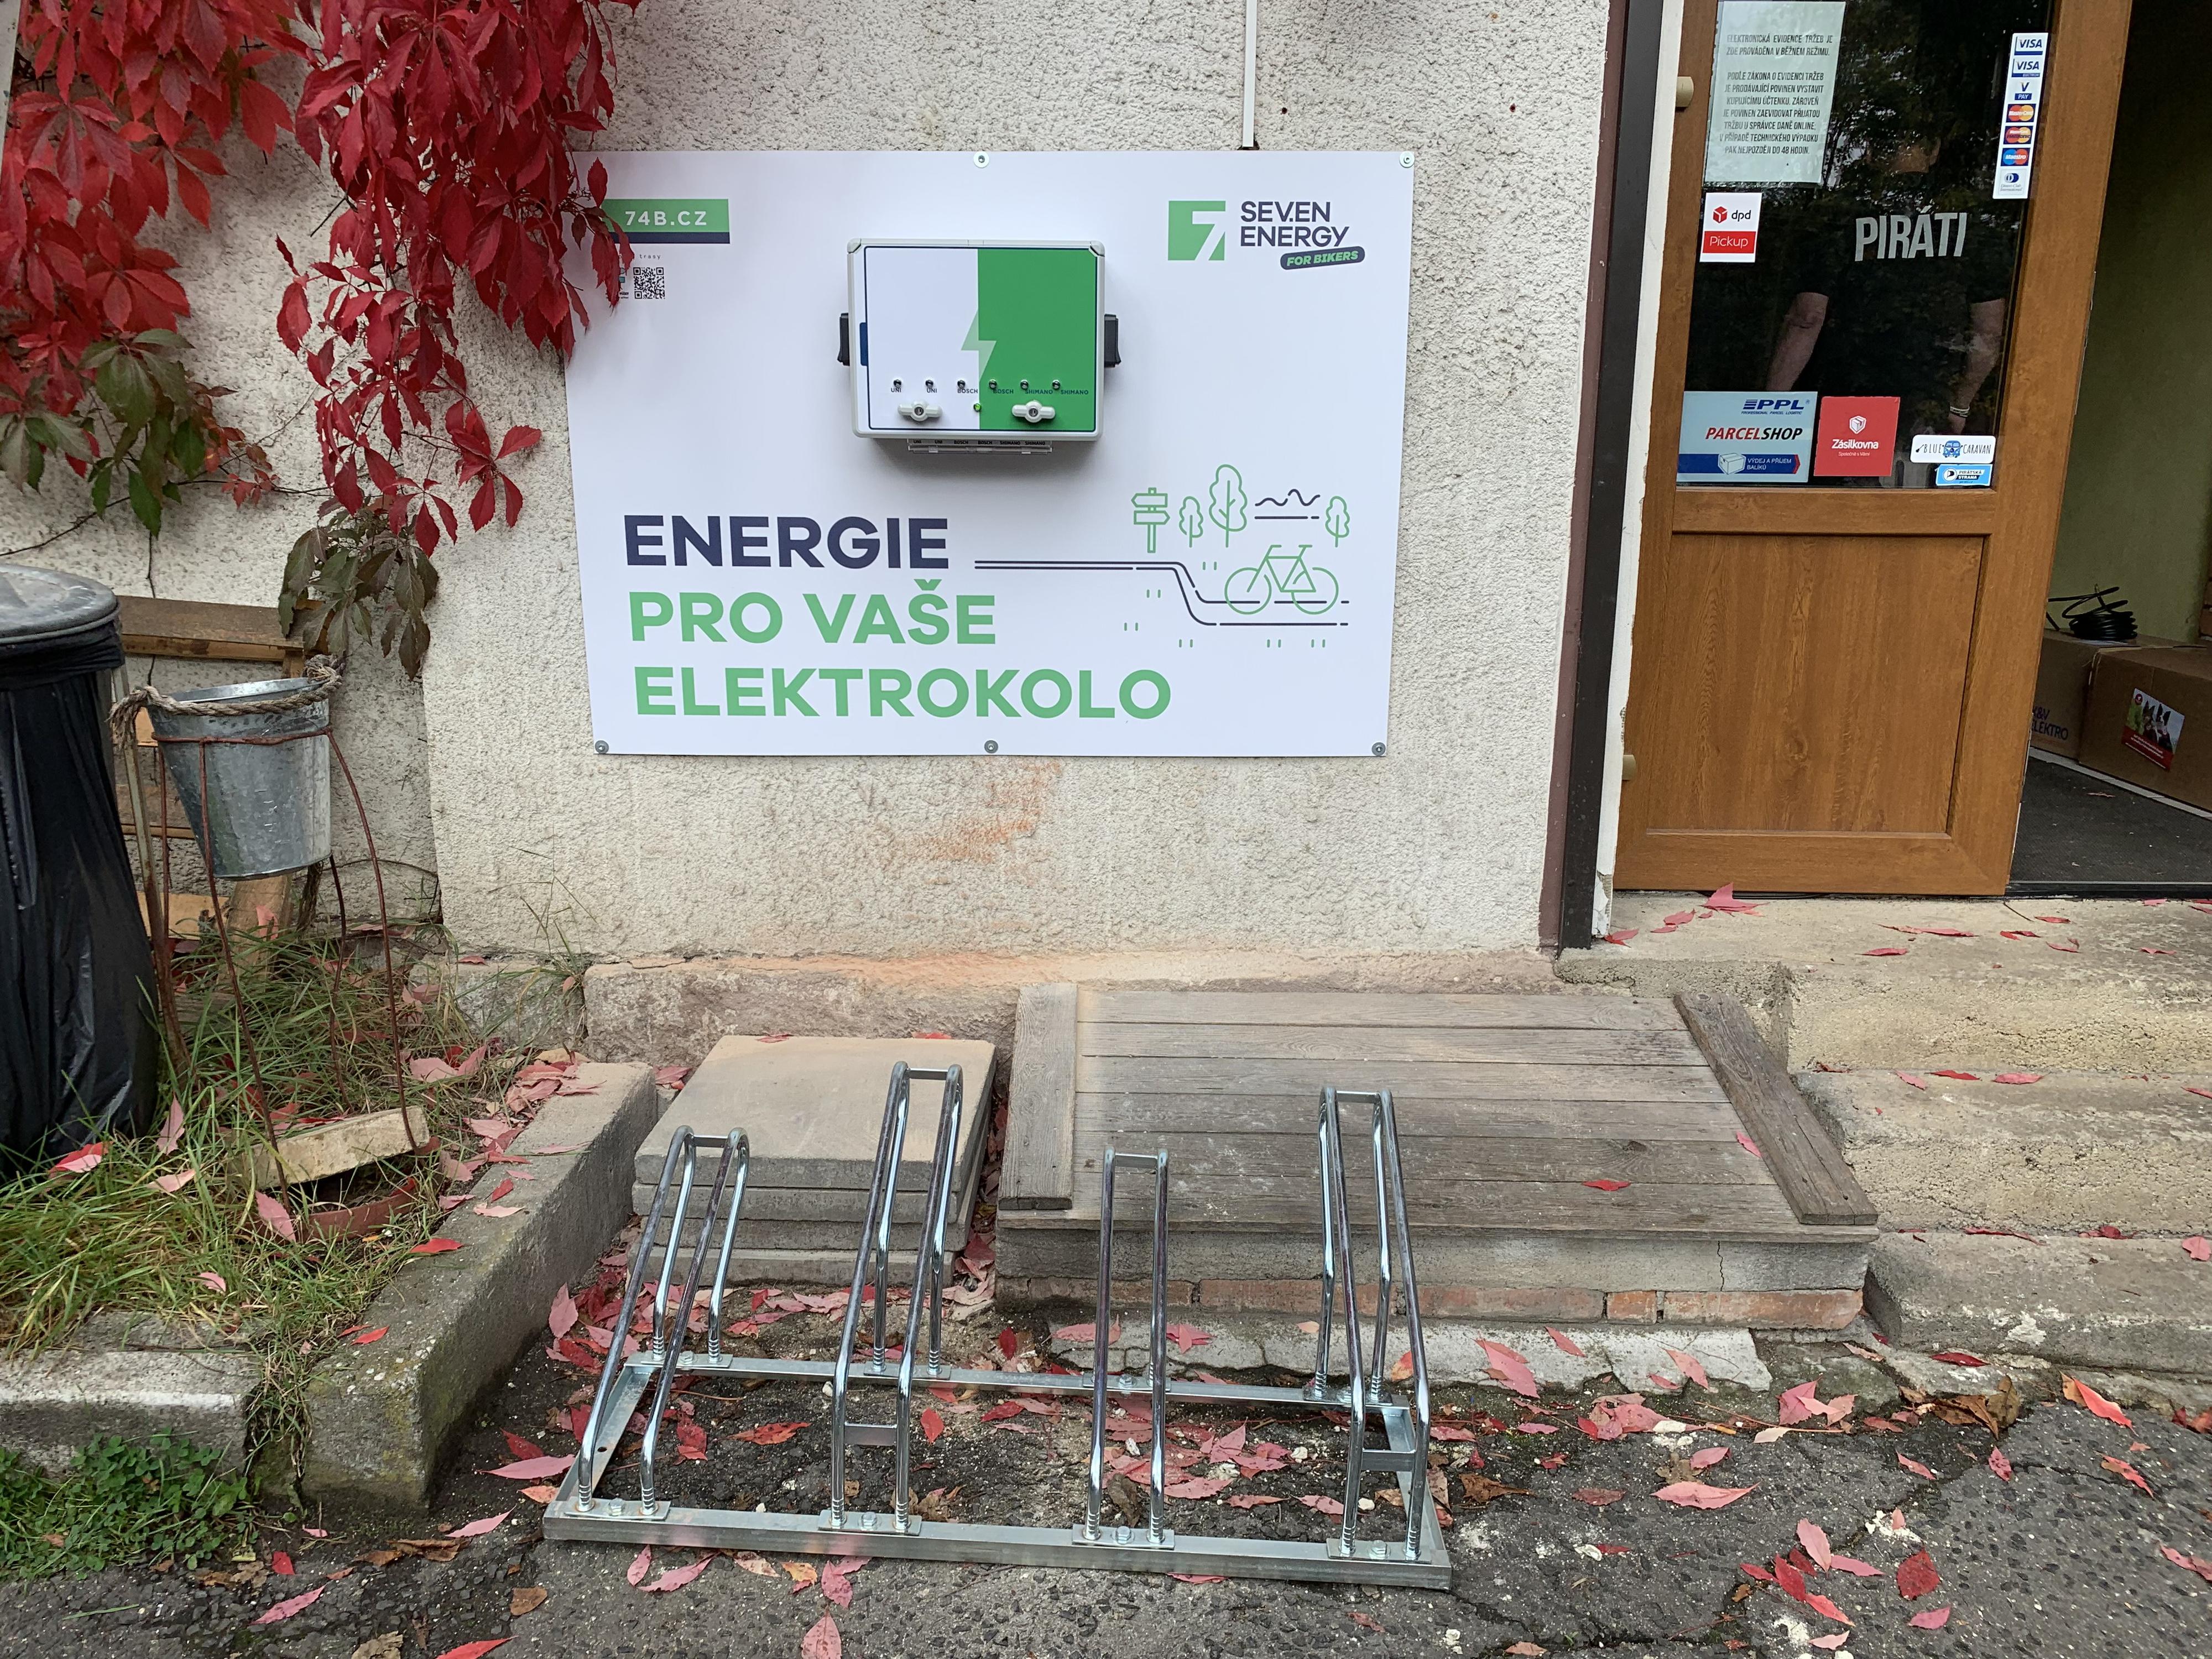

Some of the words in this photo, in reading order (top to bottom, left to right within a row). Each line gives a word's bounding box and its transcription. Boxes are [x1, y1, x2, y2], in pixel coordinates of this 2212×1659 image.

[1726, 33, 1770, 43] ELEKTRONICKÁ
[1806, 34, 1823, 43] TRŽEB
[2020, 39, 2042, 48] VISA
[1739, 46, 1773, 55] PROVÁDĚNA
[1781, 46, 1805, 55] BĚŽNÉM
[1806, 46, 1830, 55] REŽIMU.
[2017, 61, 2039, 70] VISA
[1727, 71, 1746, 80] PODLE
[1747, 71, 1770, 80] ZÁKONA
[1806, 71, 1824, 80] TRŽEB
[1732, 83, 1770, 92] PRODÁVAJÍCÍ
[2021, 82, 2030, 92] V
[1726, 96, 1761, 105] KUPUJÍCÍMU
[1792, 96, 1819, 105] ZÁROVEŇ
[1793, 108, 1820, 117] PŘIJATOU
[1724, 120, 1743, 129] TRŽBU
[1749, 120, 1776, 129] SPRÁVCE
[1777, 121, 1792, 129] DANĚ
[1719, 133, 1724, 142] V
[1724, 132, 1749, 142] PŘÍPADĚ
[1751, 133, 1790, 142] TECHNICKÉHO
[1792, 133, 1818, 142] VÝPADKU
[1738, 145, 1771, 154] NEJPOZDĚJI
[625, 211, 707, 226] 74B.CZ
[1731, 210, 1751, 221] dpd
[1240, 226, 1349, 247] ENERGY
[1709, 236, 1749, 247] Pickup
[1287, 256, 1311, 267] FOR
[1314, 251, 1358, 264] BIKERS
[1757, 400, 1804, 410] PPL
[1705, 427, 1803, 440] PARCELSHOP
[1832, 439, 1879, 449] Zásilkovna
[1924, 444, 1942, 453] BLUE
[1963, 444, 1991, 454] CARAVAN
[624, 515, 949, 569] ENERGIE
[629, 591, 783, 643] PRO
[803, 579, 996, 645] VAŠE
[634, 666, 1171, 719] ELEKTROKOLO
